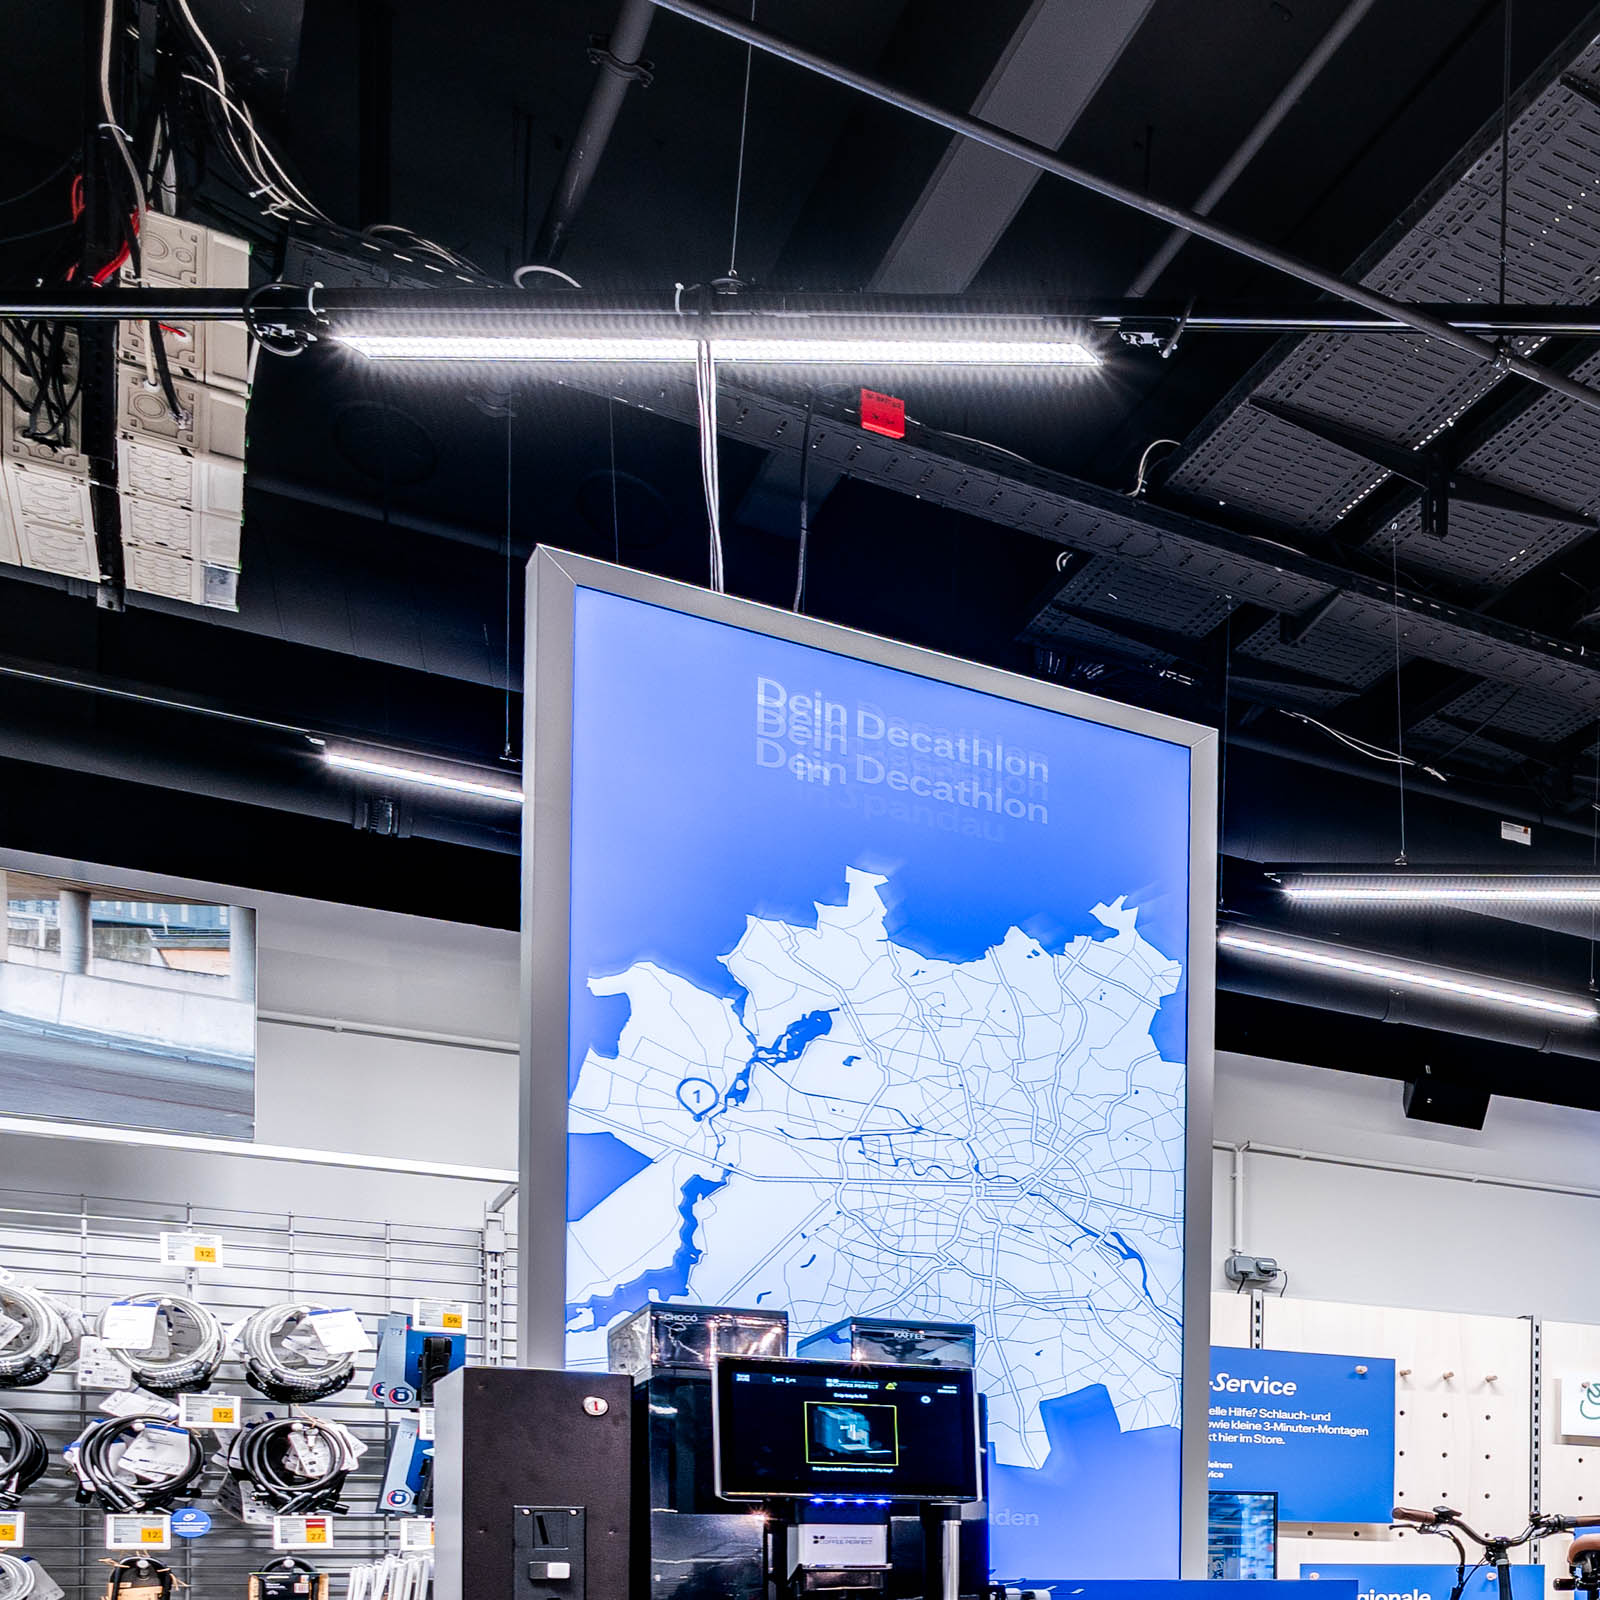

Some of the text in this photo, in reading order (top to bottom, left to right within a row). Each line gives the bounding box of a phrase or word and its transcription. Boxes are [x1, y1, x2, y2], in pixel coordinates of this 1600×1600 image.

[757, 677, 1049, 783] Dein Decathlon
[856, 753, 1048, 825] Decathlon
[1228, 1407, 1257, 1418] Hilfe?
[1311, 1412, 1331, 1422] und
[1231, 1420, 1262, 1431] kleine
[1263, 1422, 1369, 1438] 3-Minuten-Montagen
[1218, 1433, 1239, 1442] hier
[1239, 1434, 1252, 1443] im
[1253, 1434, 1286, 1445] Store.
